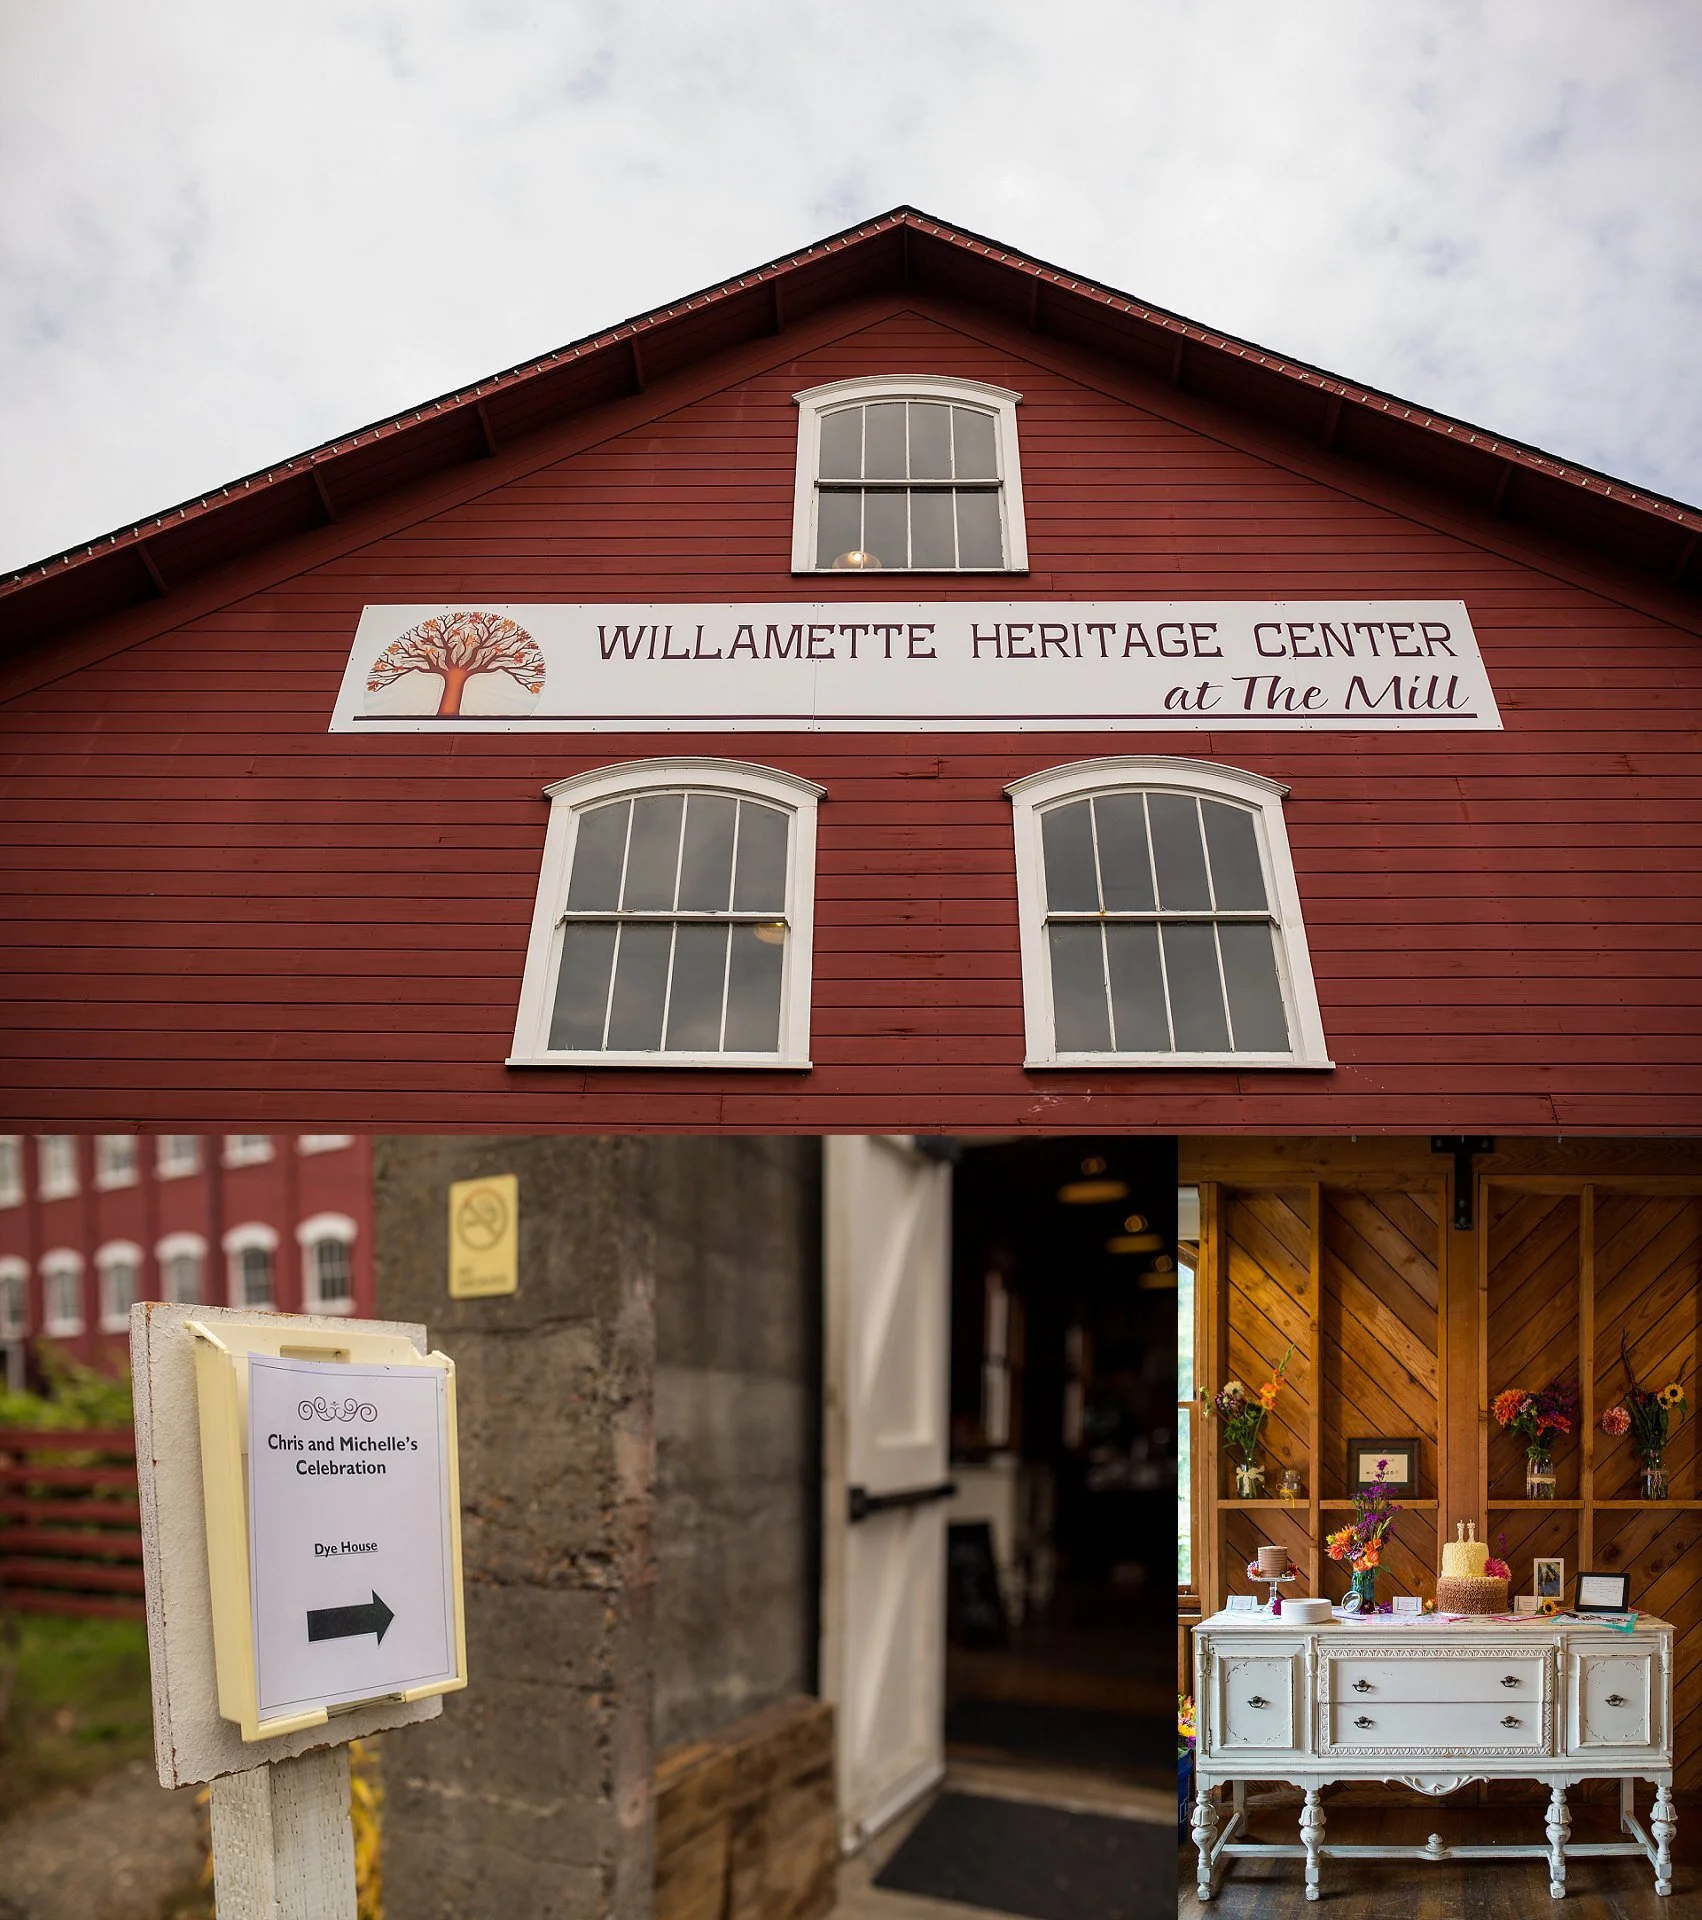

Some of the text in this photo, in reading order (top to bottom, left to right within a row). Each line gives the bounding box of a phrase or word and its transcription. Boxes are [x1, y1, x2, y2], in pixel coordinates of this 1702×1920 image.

[597, 621, 1459, 660] WILLAMETTE HERITAGE CENTER
[1164, 674, 1470, 712] at The Mill
[267, 1433, 418, 1452] Chris and Michelle’s
[295, 1459, 386, 1476] Celebration
[314, 1541, 378, 1557] Dye House
